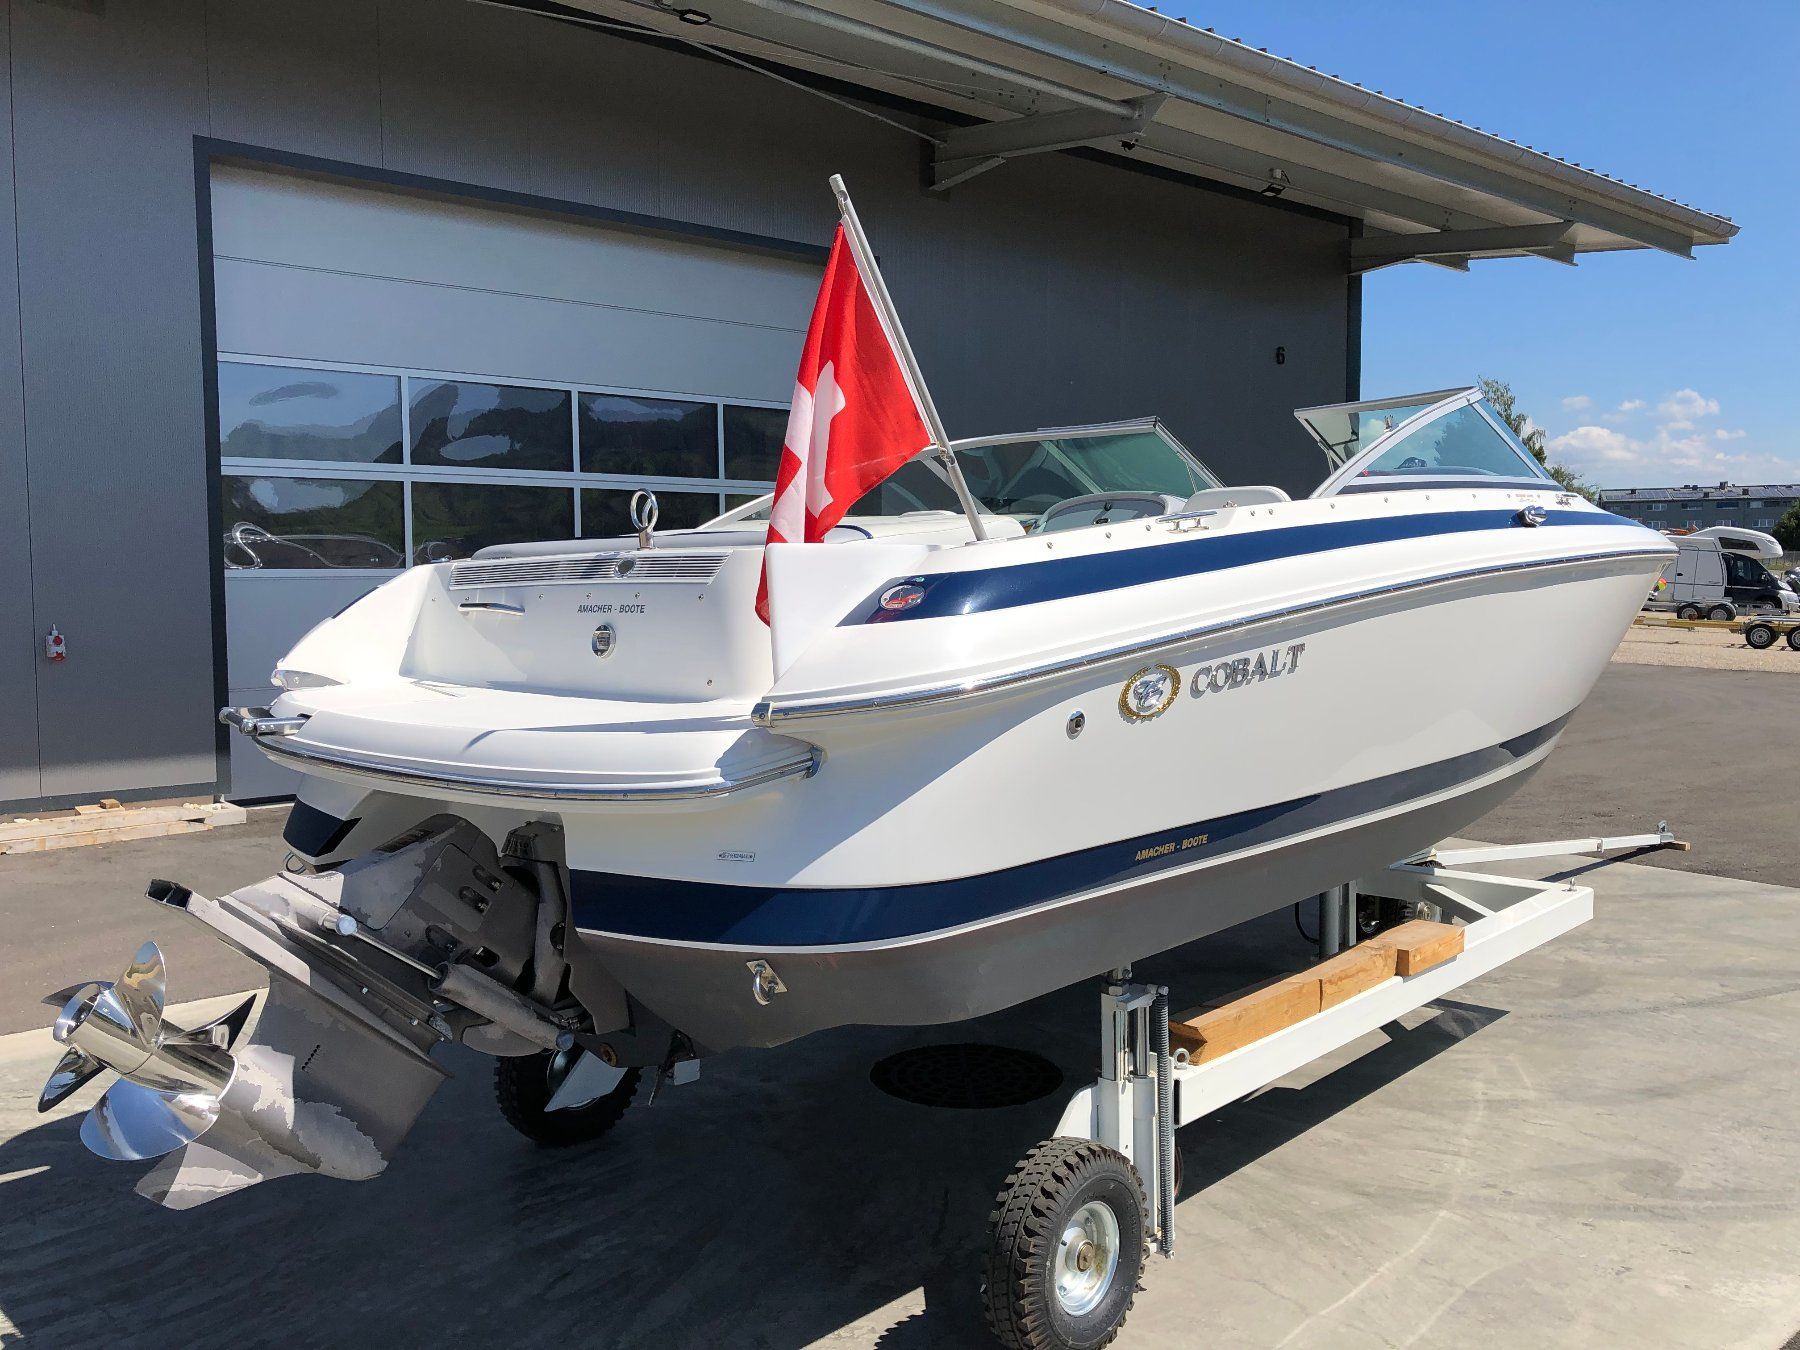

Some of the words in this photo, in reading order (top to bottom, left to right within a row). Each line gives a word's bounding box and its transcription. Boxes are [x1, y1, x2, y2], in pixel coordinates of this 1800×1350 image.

[1275, 346, 1286, 365] 6
[577, 604, 613, 614] AMACHER
[618, 604, 646, 614] BOOTE
[1190, 643, 1306, 699] COBALT
[1135, 842, 1176, 861] AMACHER
[1181, 834, 1209, 850] BOOTE
